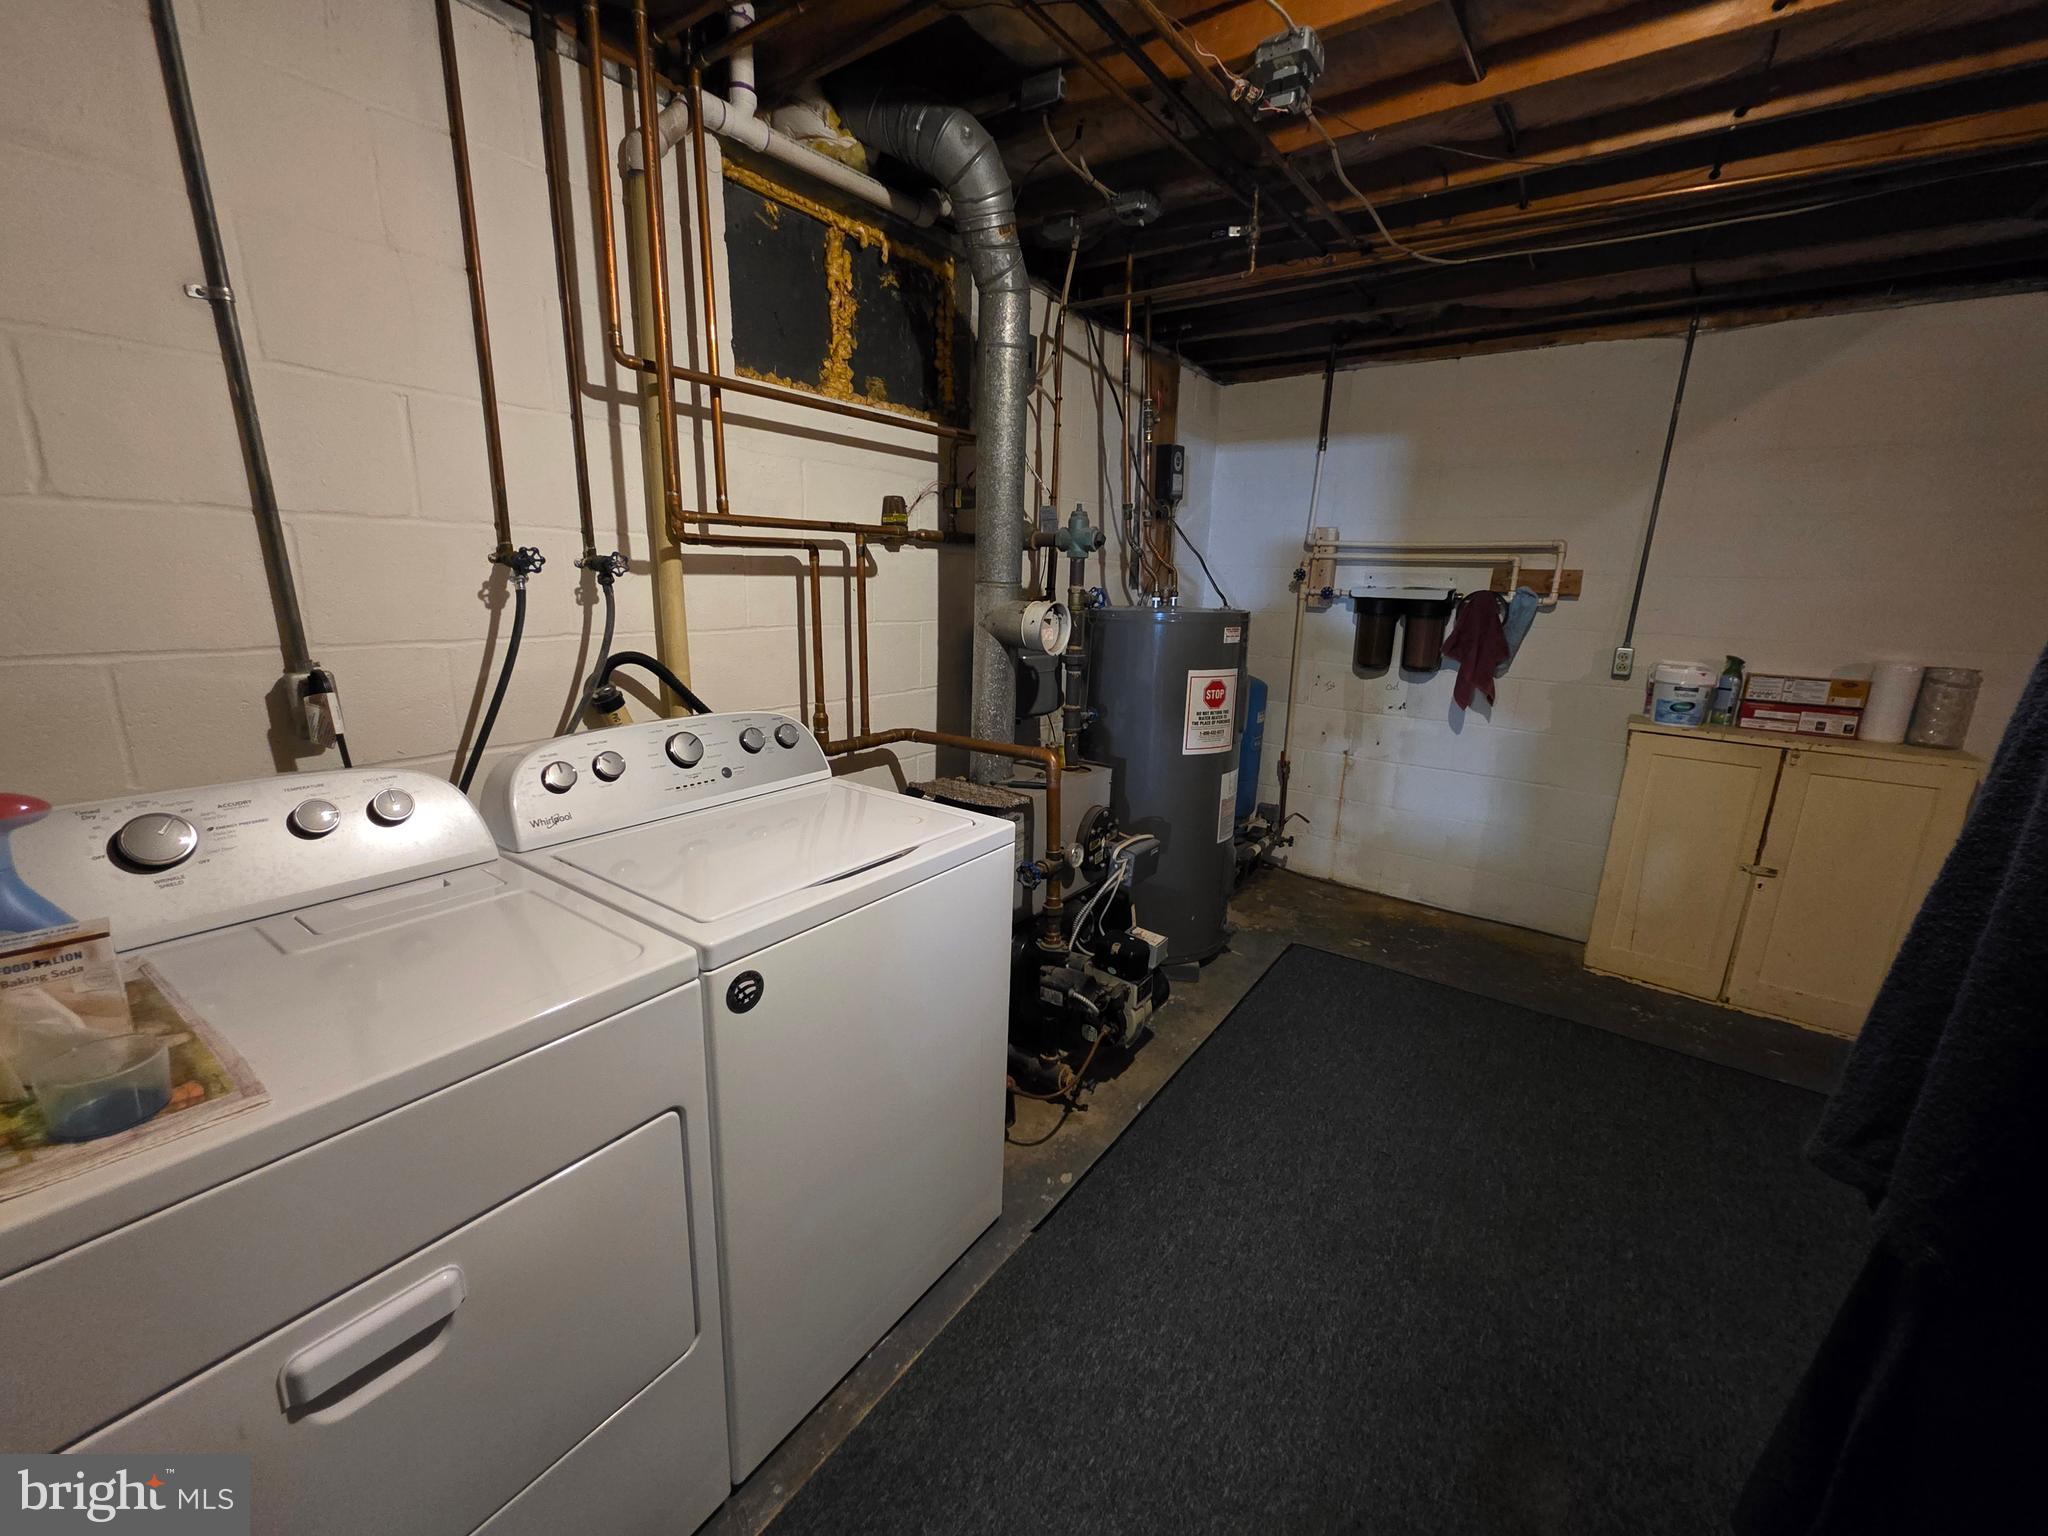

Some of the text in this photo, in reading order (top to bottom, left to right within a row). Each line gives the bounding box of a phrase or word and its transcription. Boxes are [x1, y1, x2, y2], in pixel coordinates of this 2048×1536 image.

[1206, 689, 1225, 700] STOP
[284, 783, 325, 792] TEMPERATURE
[217, 799, 252, 809] ACCUDRY
[529, 812, 573, 829] Whirlpool
[153, 874, 185, 885] WRINKLE
[53, 951, 82, 965] LION
[0, 965, 84, 989] Baking Soda
